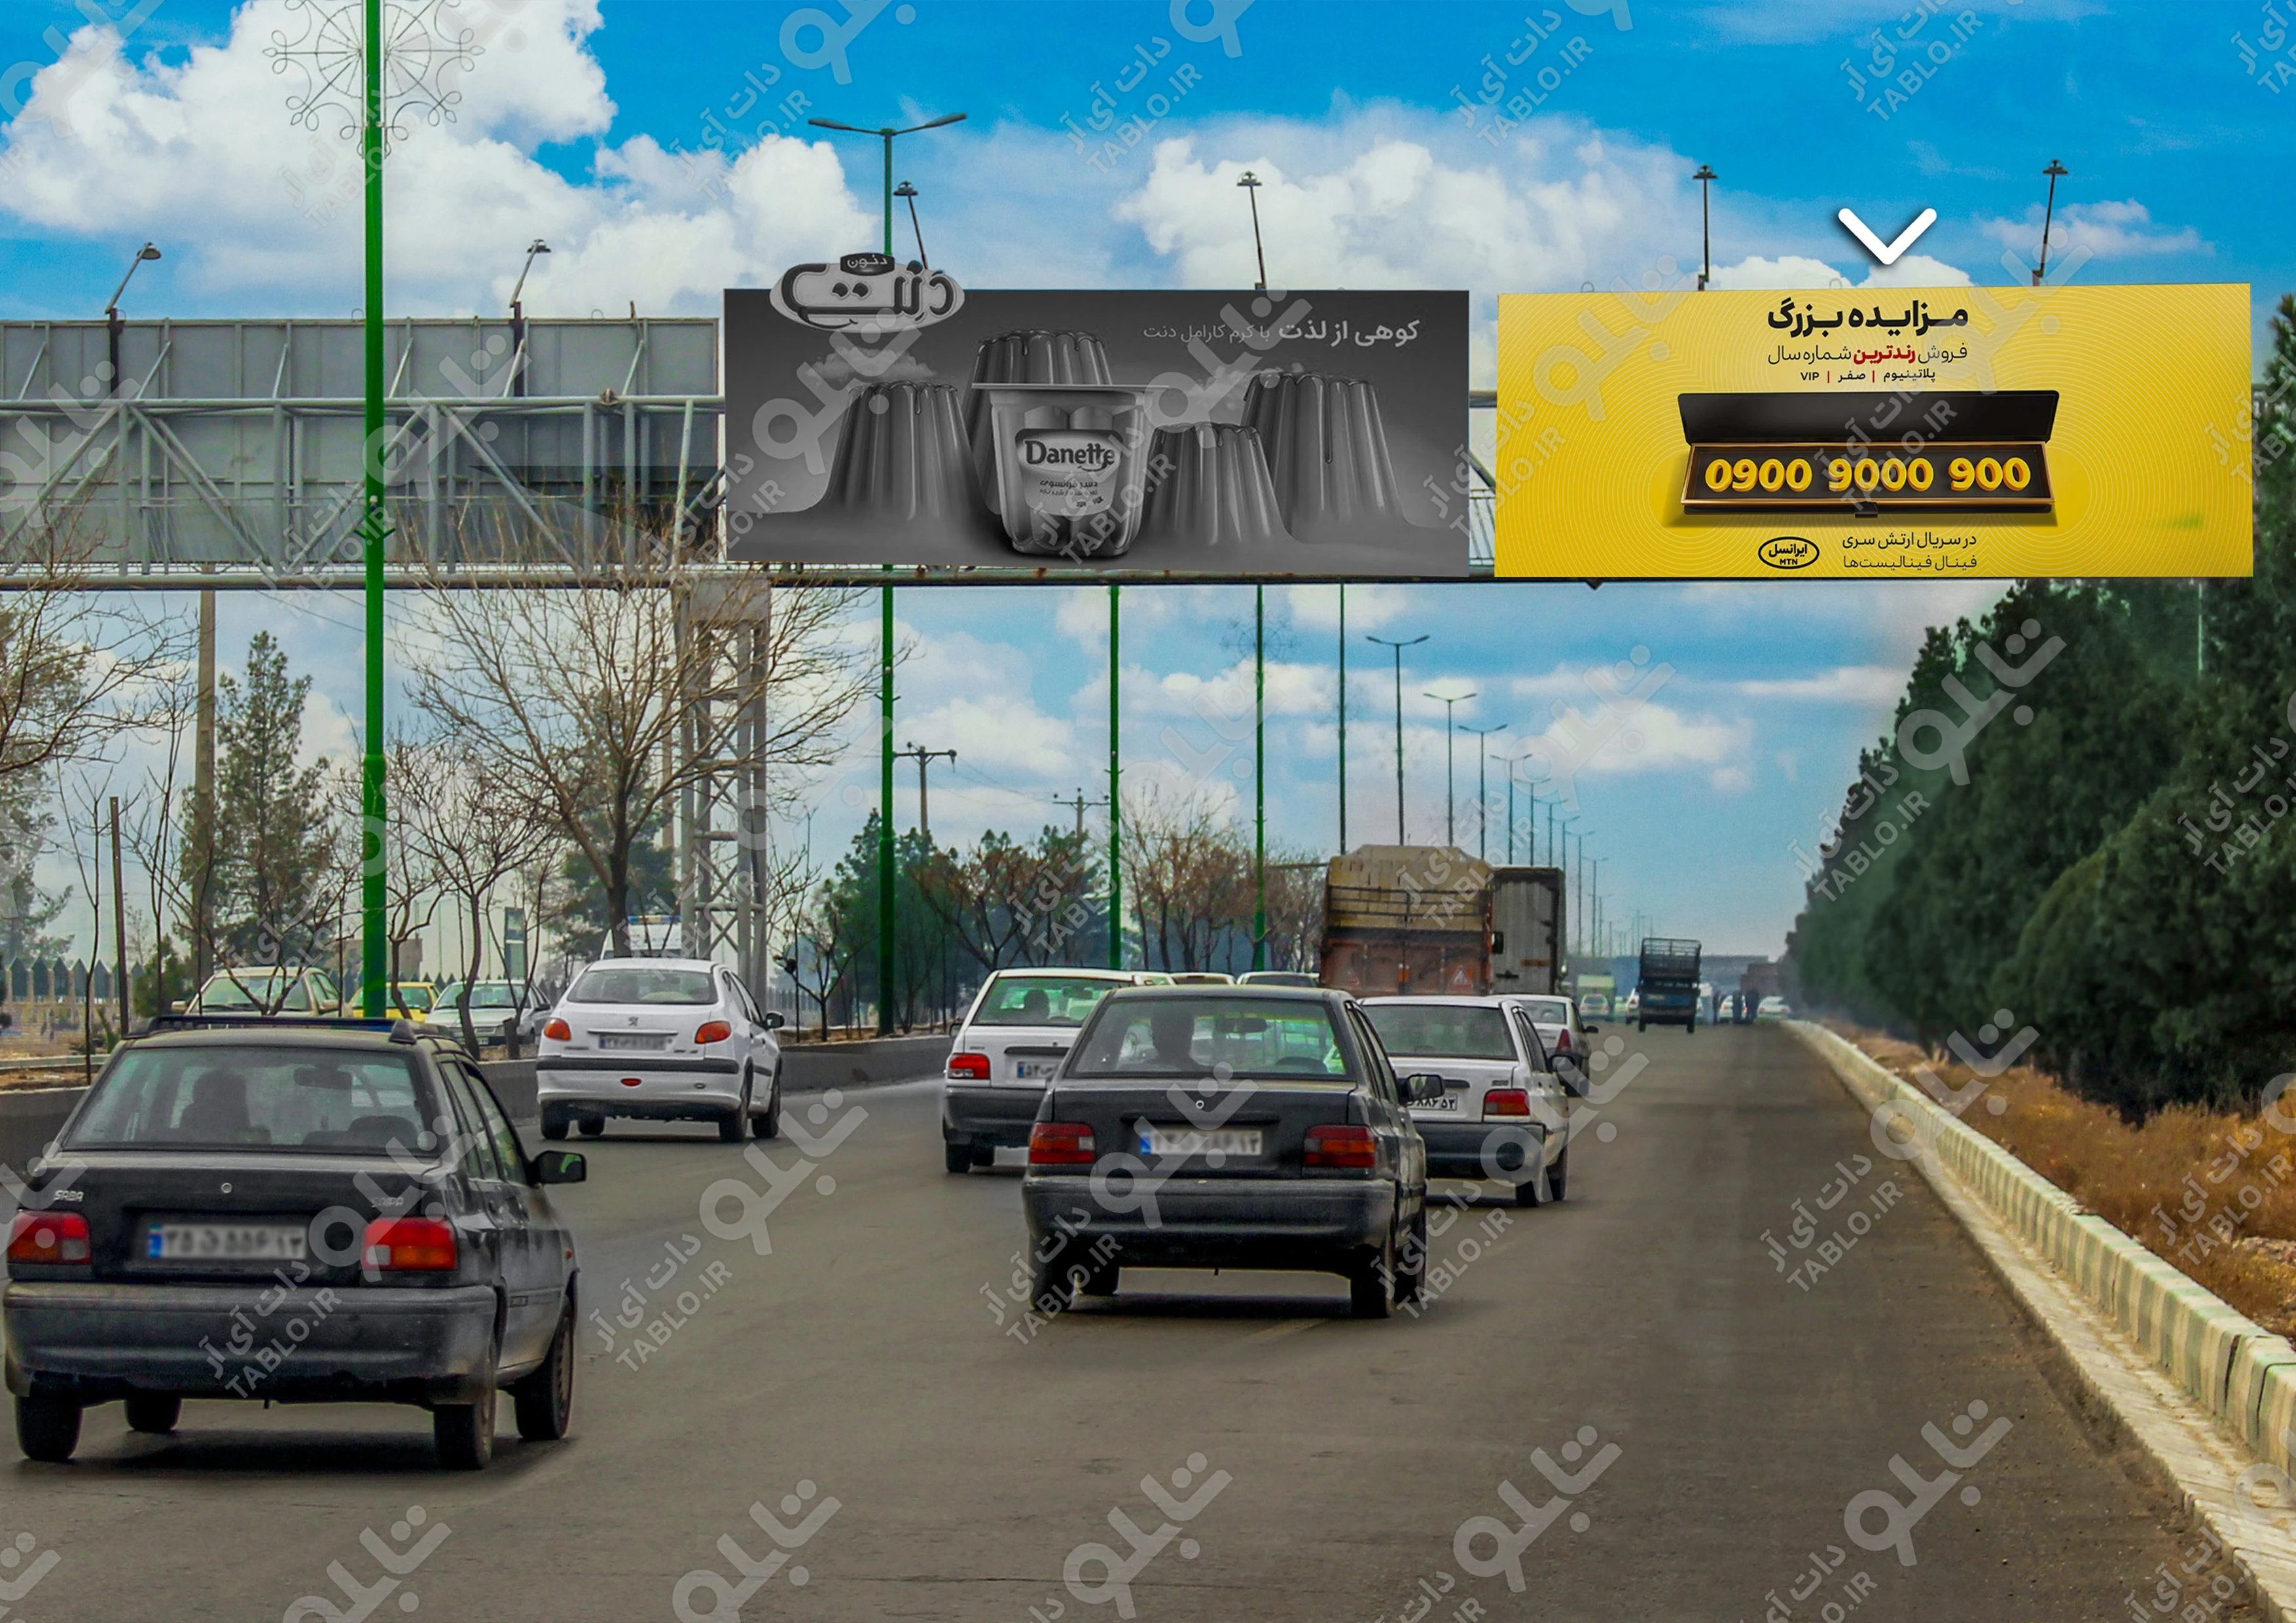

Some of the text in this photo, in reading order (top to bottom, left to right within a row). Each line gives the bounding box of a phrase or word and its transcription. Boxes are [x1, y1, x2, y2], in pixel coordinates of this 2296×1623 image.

[1768, 296, 1969, 338] مزایده بزرگ
[1143, 326, 1177, 338] دنت
[1180, 324, 1226, 344] کارامل
[1229, 325, 1255, 344] کرم
[1278, 319, 1327, 340] لذت
[1330, 320, 1348, 347] از
[1354, 319, 1420, 348] کوهی
[1768, 342, 1968, 365] فروش رندترین شماره سال
[1800, 368, 1936, 382] پلاتینیوم صفر VIP
[1024, 440, 1115, 466] Danette
[1704, 457, 2032, 492] 0900 9000 900
[1842, 531, 1977, 549] در سریال ارتش سری
[1768, 543, 1808, 558] ایرانسل
[1934, 555, 1977, 571] فینال
